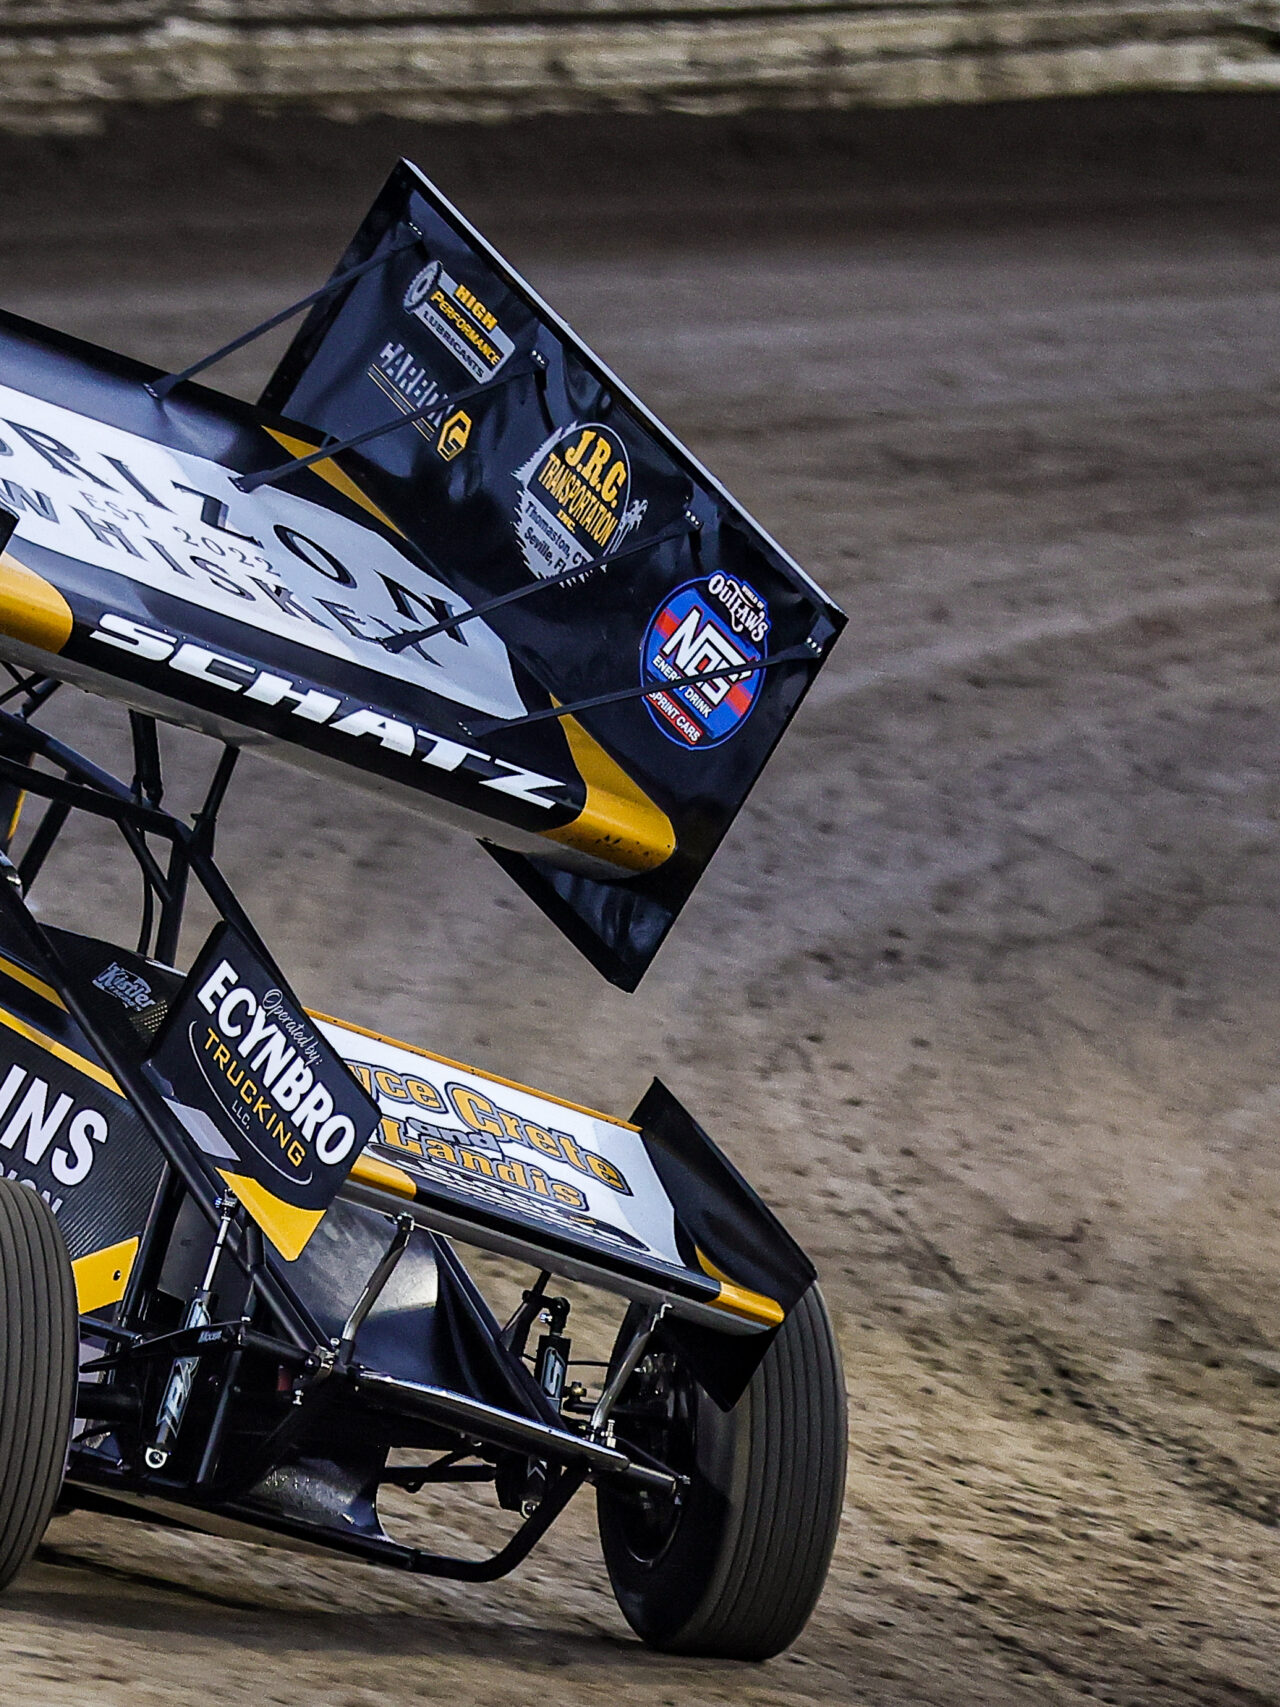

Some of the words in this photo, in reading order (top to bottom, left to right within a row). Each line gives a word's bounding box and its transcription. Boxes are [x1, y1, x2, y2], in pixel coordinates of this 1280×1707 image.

[422, 310, 484, 378] LUBRICANTS
[430, 290, 502, 366] PERFORMANCE
[454, 284, 498, 331] HIGH
[538, 452, 618, 548] TRANSPORTATION
[564, 430, 627, 509] J.R.C.
[79, 490, 147, 529] EST
[173, 526, 281, 577] 2022
[524, 501, 571, 560] Thomaston,
[524, 526, 553, 566] Seville,
[662, 607, 752, 706] NOS
[90, 611, 567, 809] SCHATZ
[649, 690, 680, 720] SPRINT
[676, 716, 701, 743] CARS
[684, 689, 713, 719] DRINK
[197, 959, 356, 1165] ECYNBRO
[262, 988, 310, 1048] Operated
[307, 1039, 323, 1066] by:
[204, 1027, 306, 1167] TRUCKING
[406, 1116, 500, 1151] and
[378, 1116, 586, 1211] Landis
[447, 1083, 630, 1194] Crete
